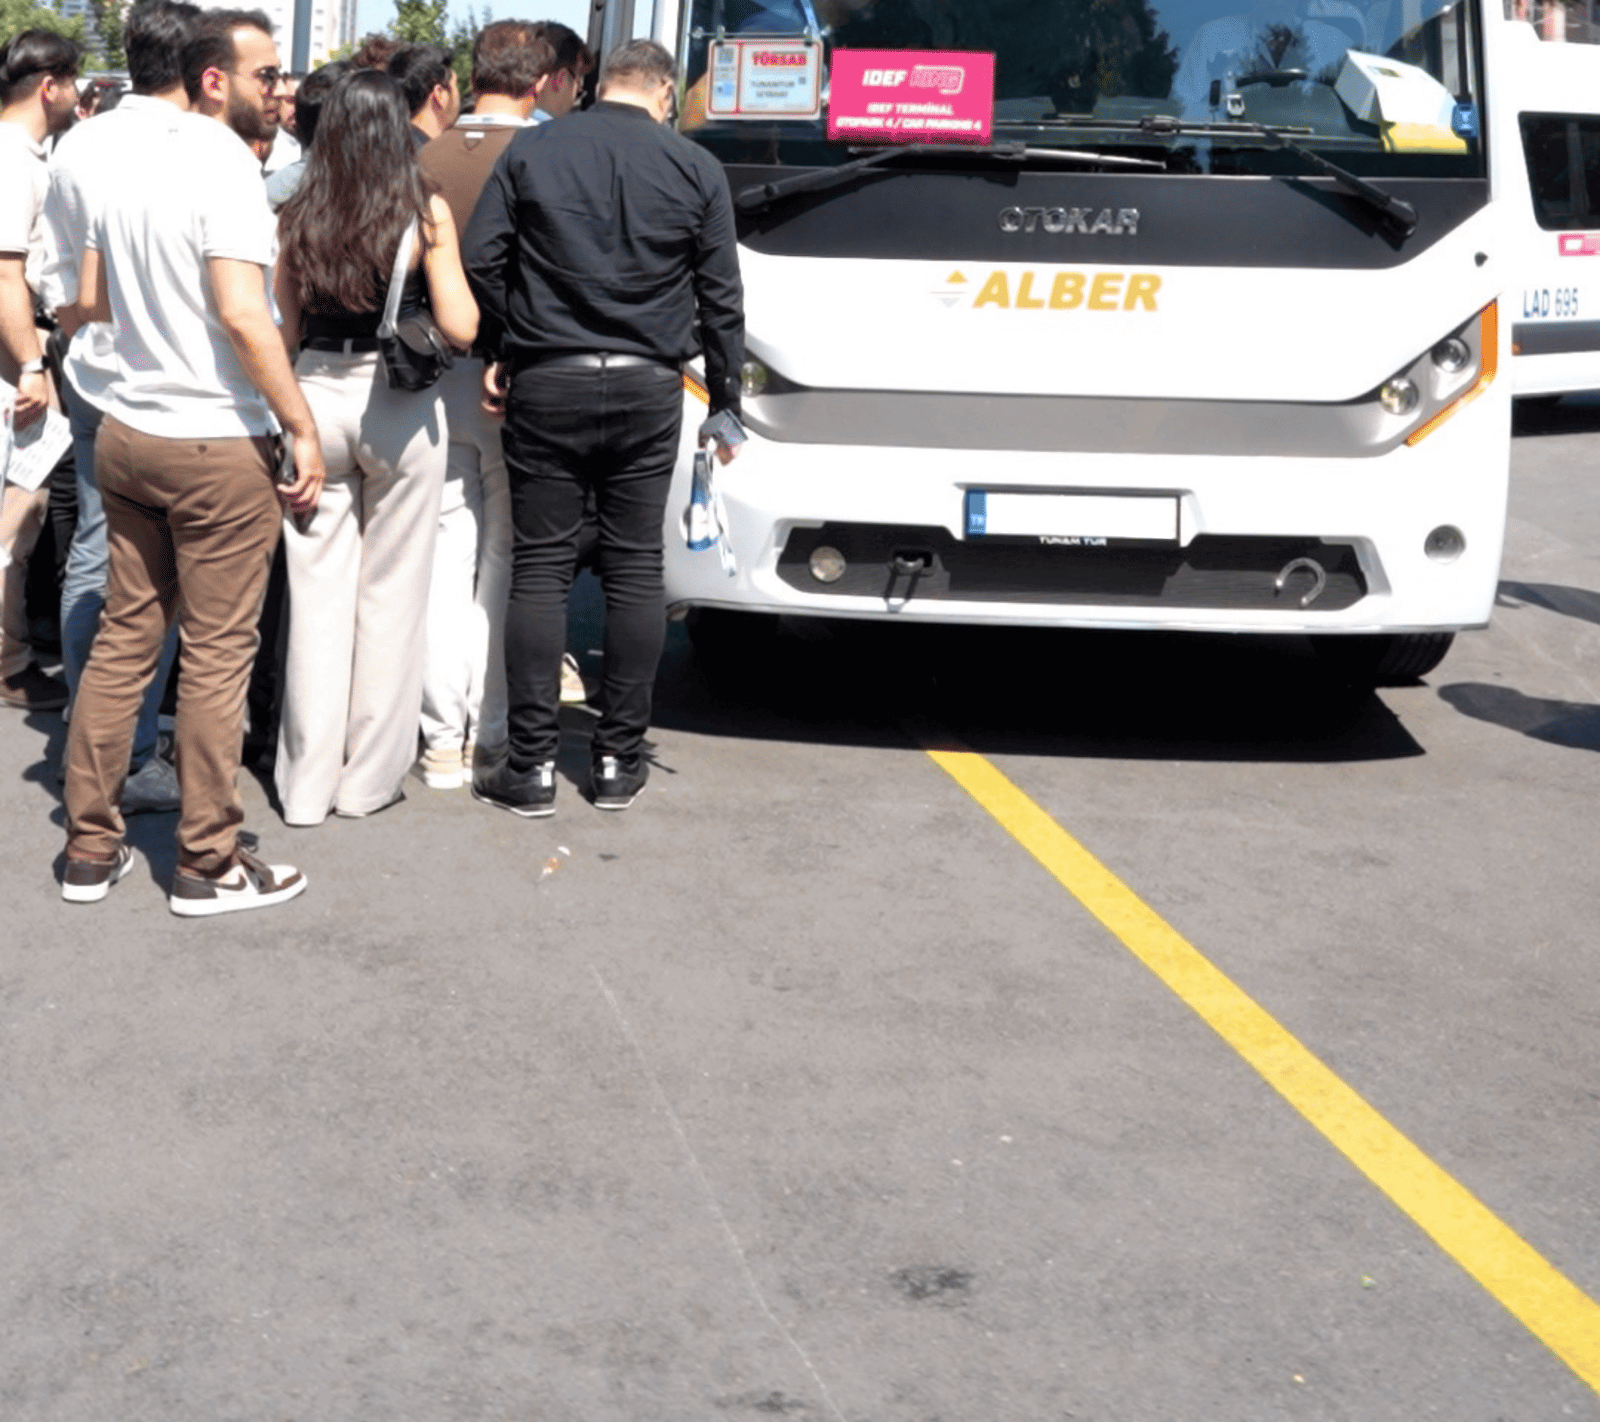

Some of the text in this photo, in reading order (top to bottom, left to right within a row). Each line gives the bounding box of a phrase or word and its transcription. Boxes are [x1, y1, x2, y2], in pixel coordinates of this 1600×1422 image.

[752, 49, 807, 66] TÜRSAB
[862, 69, 908, 87] IDEF
[902, 118, 925, 129] CAR
[925, 118, 973, 131] PARKING
[998, 205, 1141, 236] OTOKAR
[971, 270, 1163, 313] ALBER
[1523, 286, 1579, 319] LAD 695
